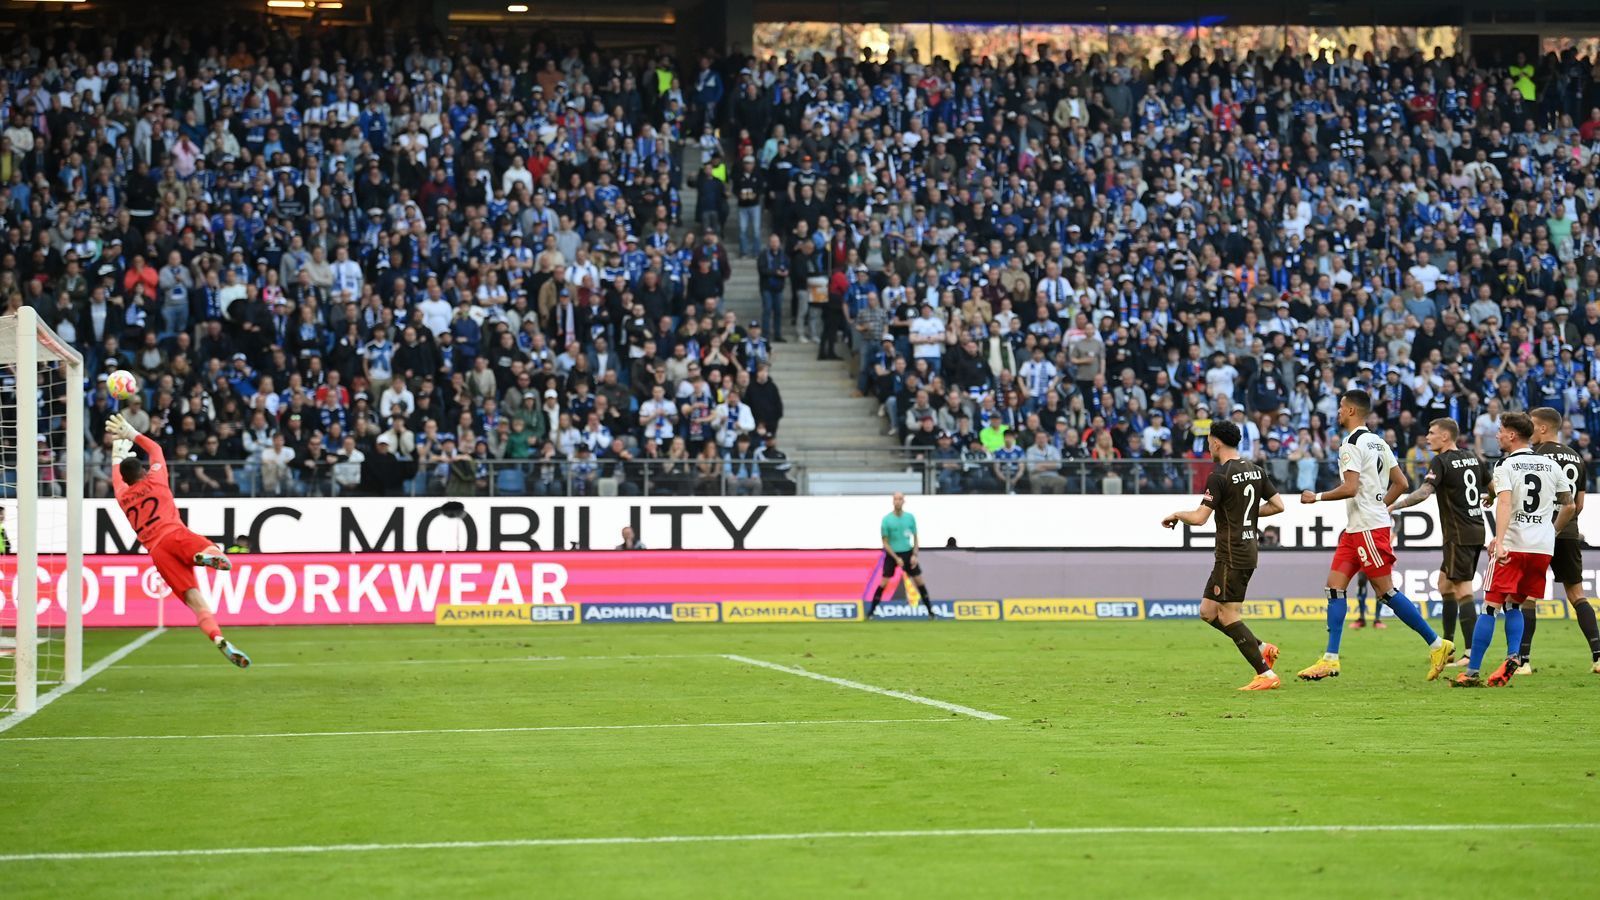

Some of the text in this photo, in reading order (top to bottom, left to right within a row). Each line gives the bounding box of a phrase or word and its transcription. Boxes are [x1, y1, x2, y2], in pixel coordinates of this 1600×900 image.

[1451, 460, 1463, 469] ST.
[1557, 453, 1580, 463] PAULI
[1231, 472, 1245, 484] ST.
[1463, 469, 1479, 507] 8
[1242, 483, 1255, 527] 2
[1523, 473, 1541, 513] 3
[126, 496, 160, 534] 22
[1515, 513, 1542, 524] HEYER
[1357, 546, 1368, 563] 9
[193, 562, 569, 615] WORKWEAR
